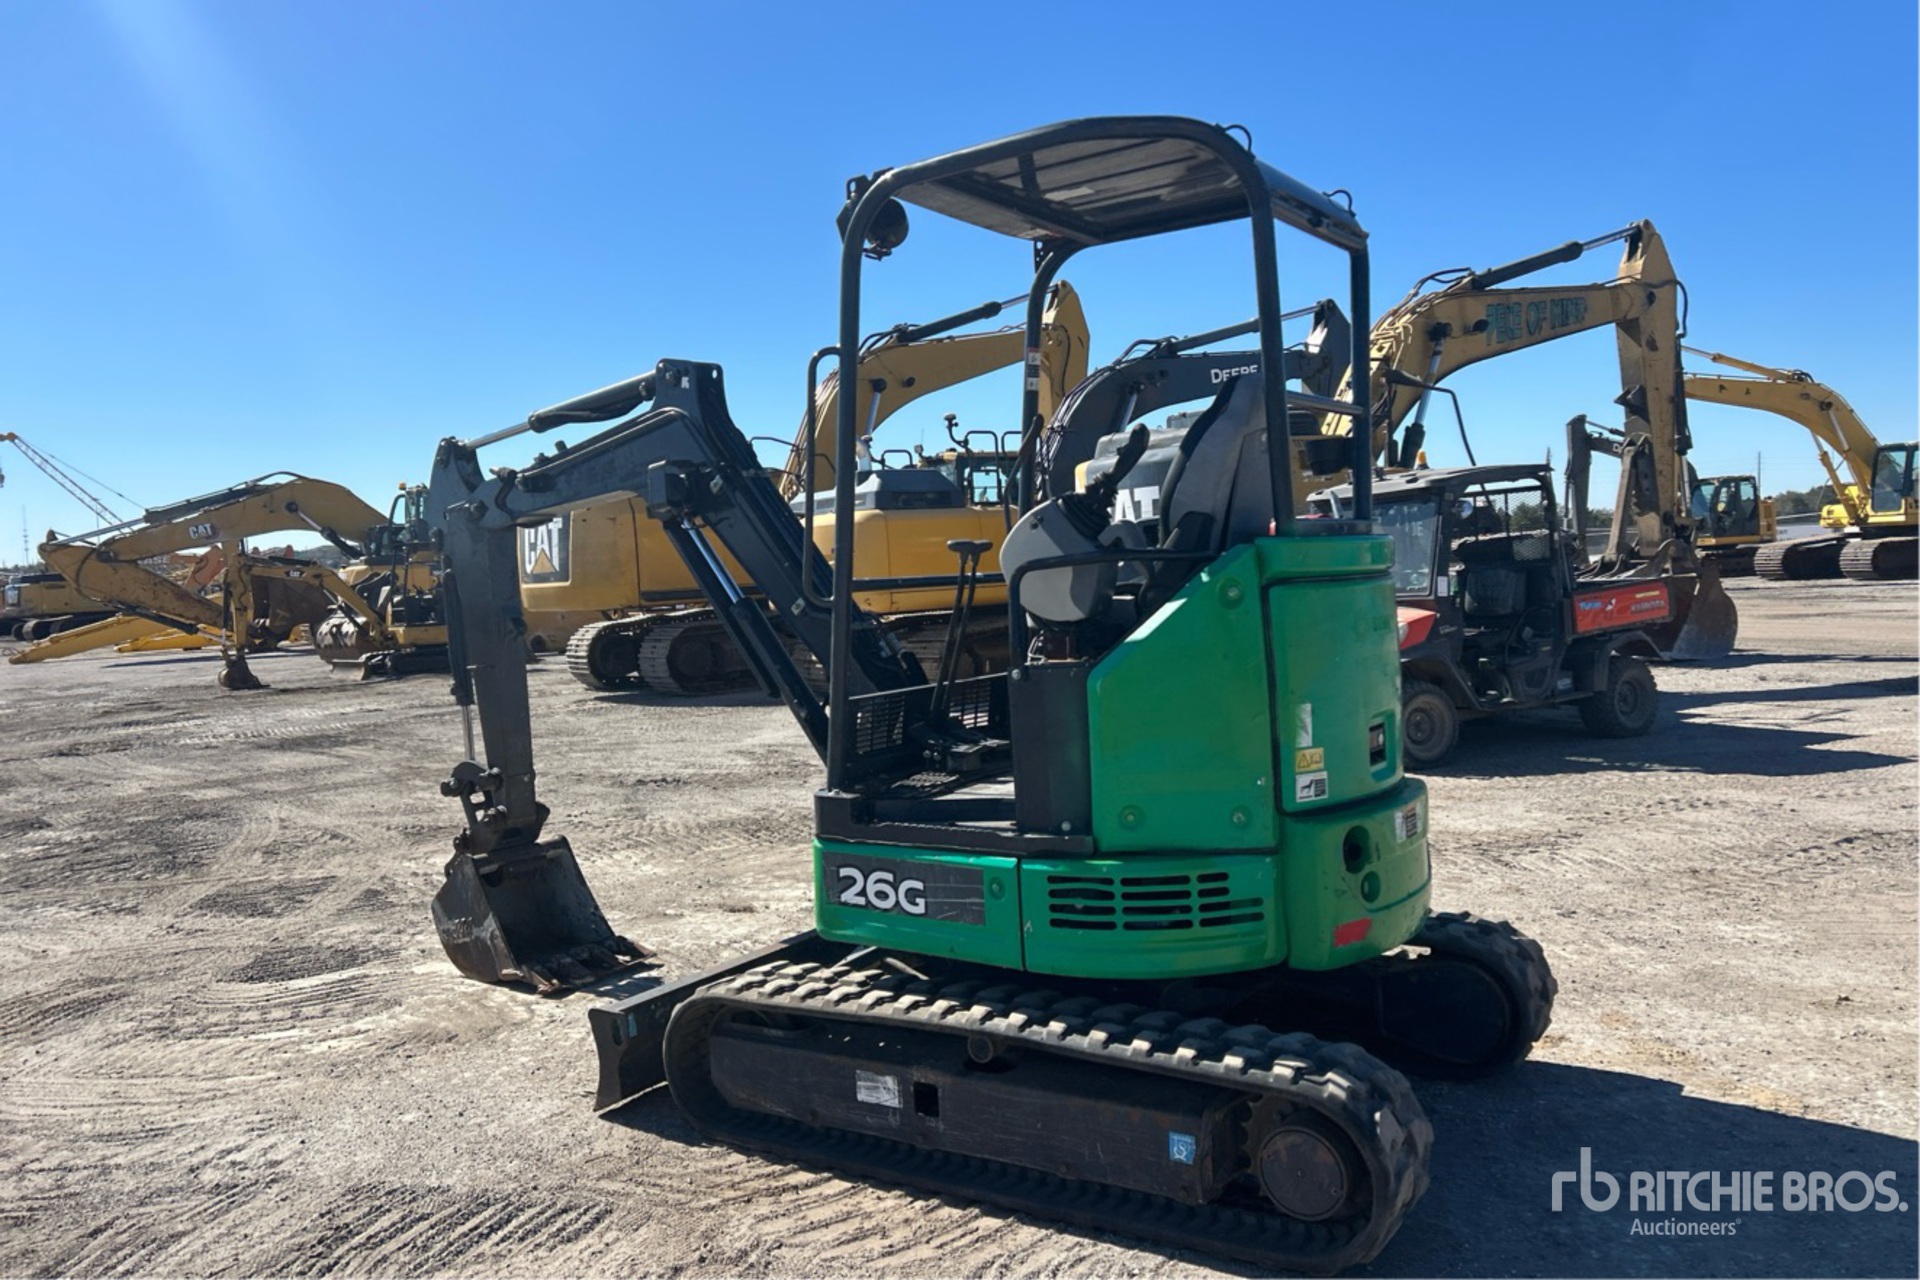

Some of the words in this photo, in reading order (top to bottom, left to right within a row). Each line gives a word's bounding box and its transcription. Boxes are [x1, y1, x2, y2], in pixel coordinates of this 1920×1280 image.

[1107, 485, 1160, 524] AT
[188, 523, 213, 540] CAT
[524, 517, 563, 575] CAT
[838, 867, 927, 915] 26G
